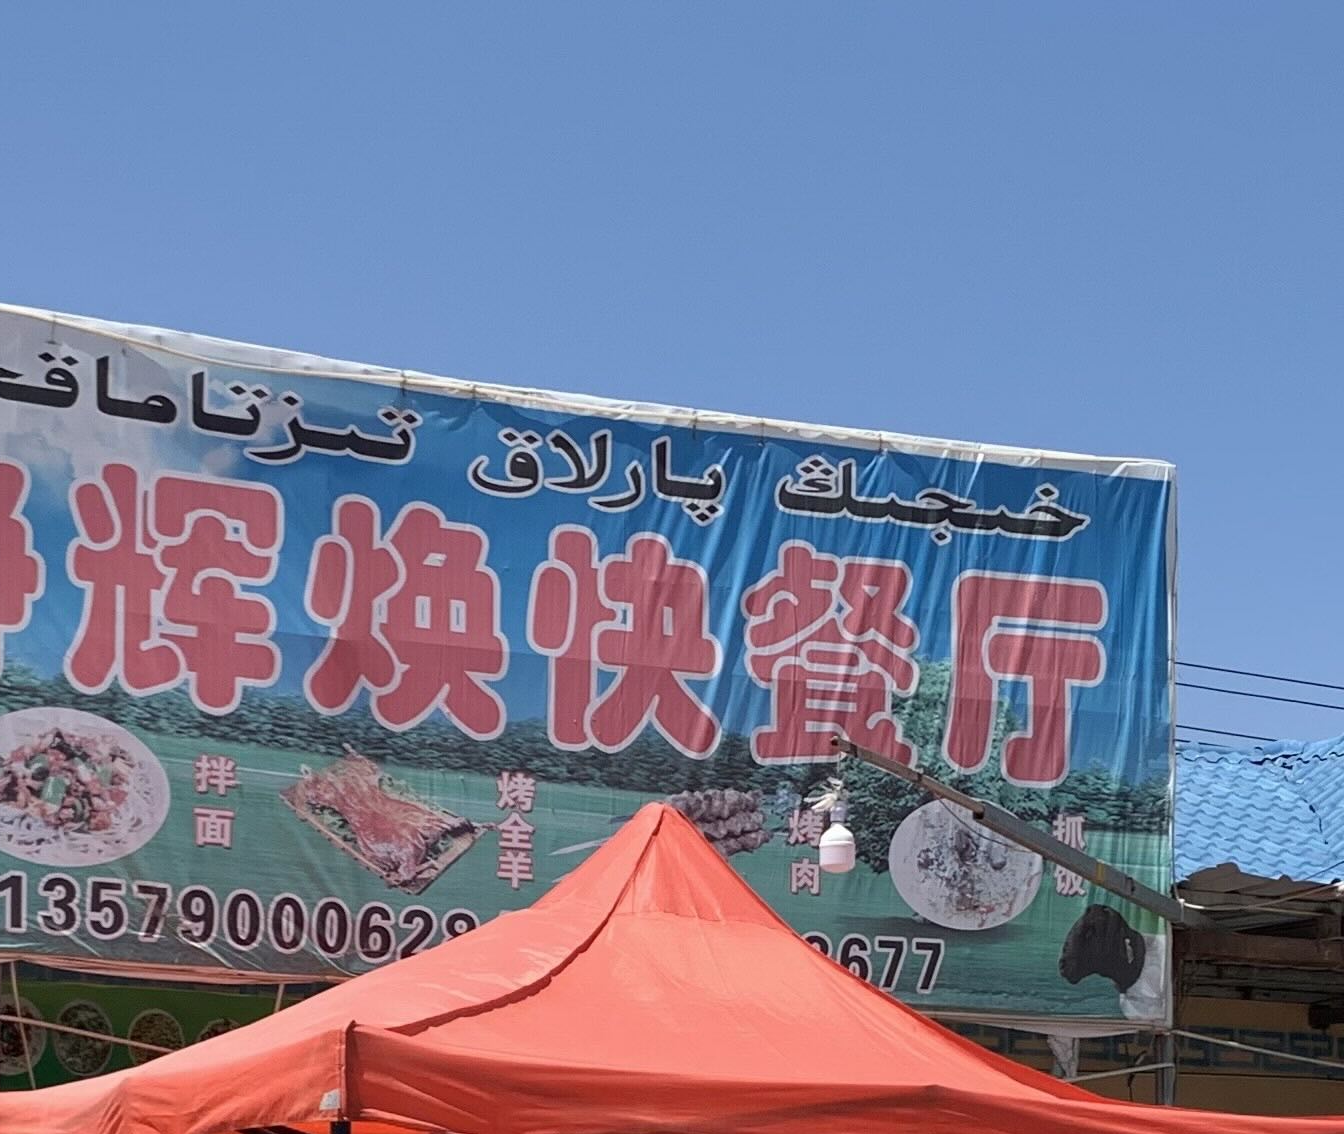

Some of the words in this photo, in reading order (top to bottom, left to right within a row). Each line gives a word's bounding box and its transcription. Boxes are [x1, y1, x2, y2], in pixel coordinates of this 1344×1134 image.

[468, 427, 725, 526] پارلاق
[192, 752, 239, 850] 拌面
[495, 771, 537, 890] 烤全羊
